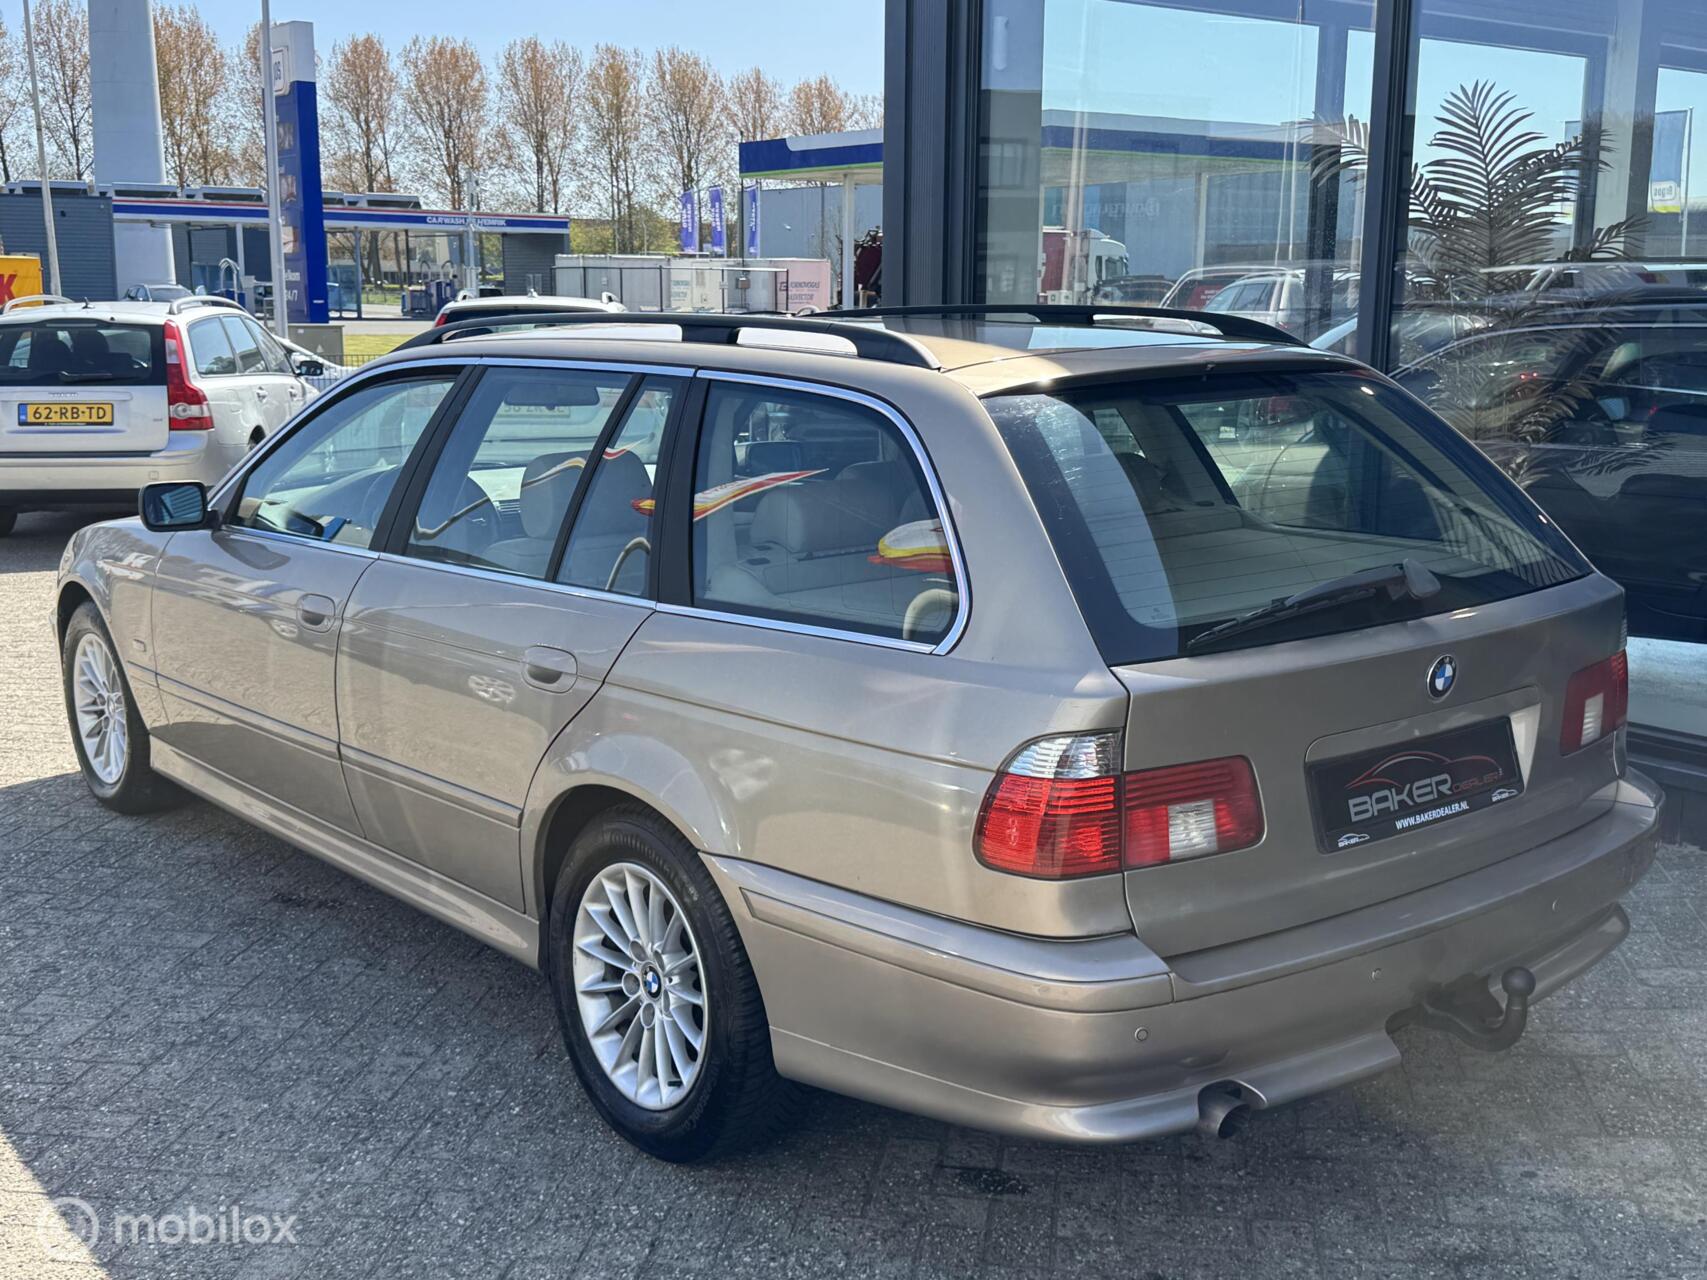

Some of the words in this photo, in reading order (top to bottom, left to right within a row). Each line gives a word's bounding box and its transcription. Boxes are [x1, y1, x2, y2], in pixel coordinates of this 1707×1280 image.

[426, 216, 465, 225] CARWASH
[33, 406, 106, 420] 62-RB-TD
[1349, 773, 1452, 822] BAKER
[1395, 800, 1470, 830] WWW.BAKERDEALER.NL
